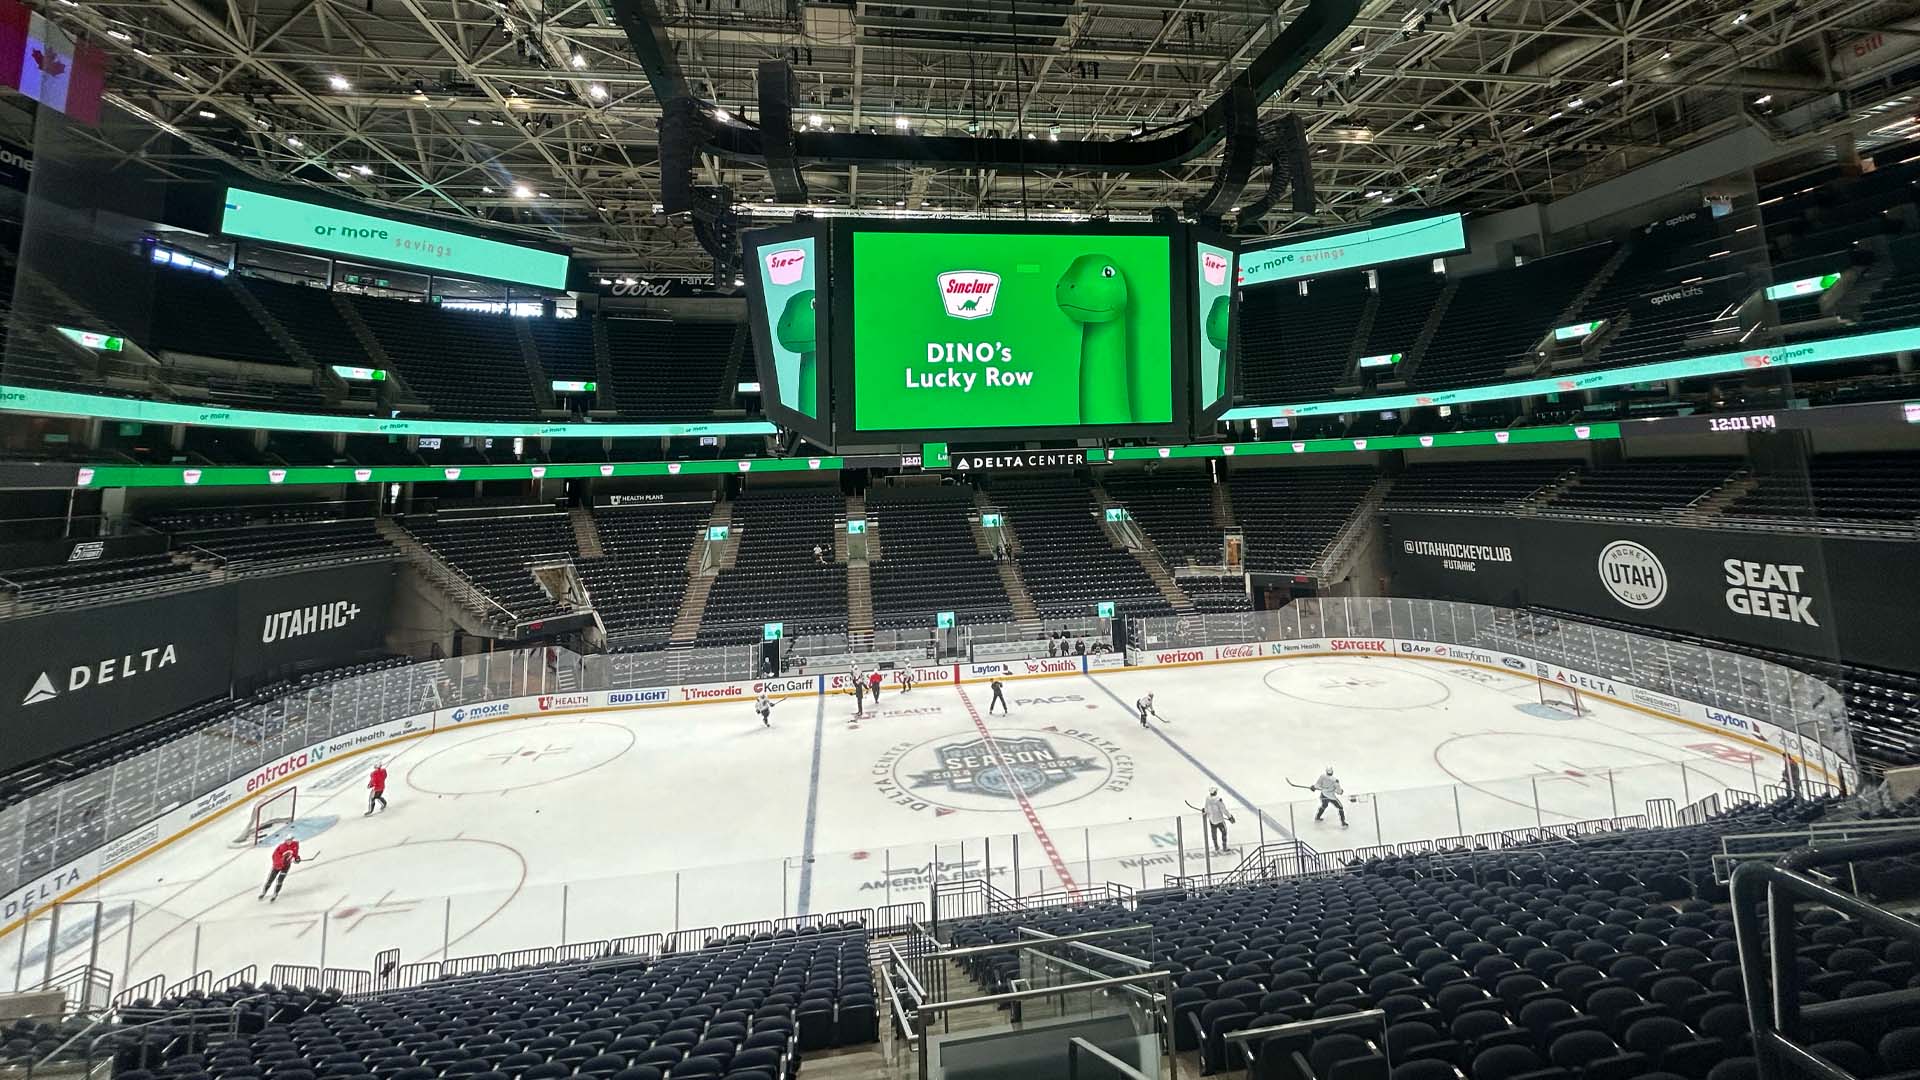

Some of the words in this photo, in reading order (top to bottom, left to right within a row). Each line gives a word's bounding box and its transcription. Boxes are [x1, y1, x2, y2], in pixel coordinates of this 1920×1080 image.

[314, 225, 336, 236] or
[341, 225, 388, 240] more
[395, 237, 452, 257] savings
[1248, 265, 1261, 274] or
[1263, 253, 1294, 270] more
[611, 279, 672, 296] Ford
[946, 279, 994, 294] Sinclair
[927, 341, 1012, 363] DINO's
[1785, 347, 1814, 360] more
[906, 367, 977, 392] Lucky
[985, 366, 1034, 387] Row
[1709, 416, 1750, 431] 12:01
[1751, 415, 1776, 429] PM
[973, 457, 1024, 468] DELTA
[1028, 454, 1083, 466] CENTER
[1404, 540, 1513, 562] @UTAHHOCKEYCLUB
[1612, 548, 1648, 562] HOCKEY
[1443, 560, 1476, 572] #UTAHHC
[1608, 562, 1657, 589] UTAH
[1723, 558, 1805, 593] SEAT
[1623, 590, 1648, 601] CLUB
[1725, 587, 1820, 628] GEEK
[1331, 639, 1387, 652] SEATGEEK
[1156, 649, 1204, 664] verizon
[1449, 647, 1492, 664] Interform
[69, 644, 177, 691] DELTA
[972, 664, 1000, 675] Layton
[1040, 660, 1077, 673] Smith's
[690, 686, 742, 699] Trucordia
[764, 681, 785, 693] Ken
[787, 679, 814, 691] Garff
[1570, 673, 1616, 696] DELTA
[555, 696, 589, 706] HEALTH
[610, 693, 635, 703] BUD
[636, 690, 667, 702] LIGHT
[1015, 694, 1085, 706] PACS
[470, 703, 510, 716] moxie
[1705, 707, 1749, 730] Layton
[329, 738, 353, 754] Nomi
[355, 730, 385, 745] Health
[1064, 728, 1121, 754] DELTA
[945, 750, 1054, 770] SEASON
[246, 753, 308, 793] entrata
[874, 778, 929, 812] DELTA
[1118, 854, 1174, 869] Nomi
[5, 867, 80, 919] DELTA
